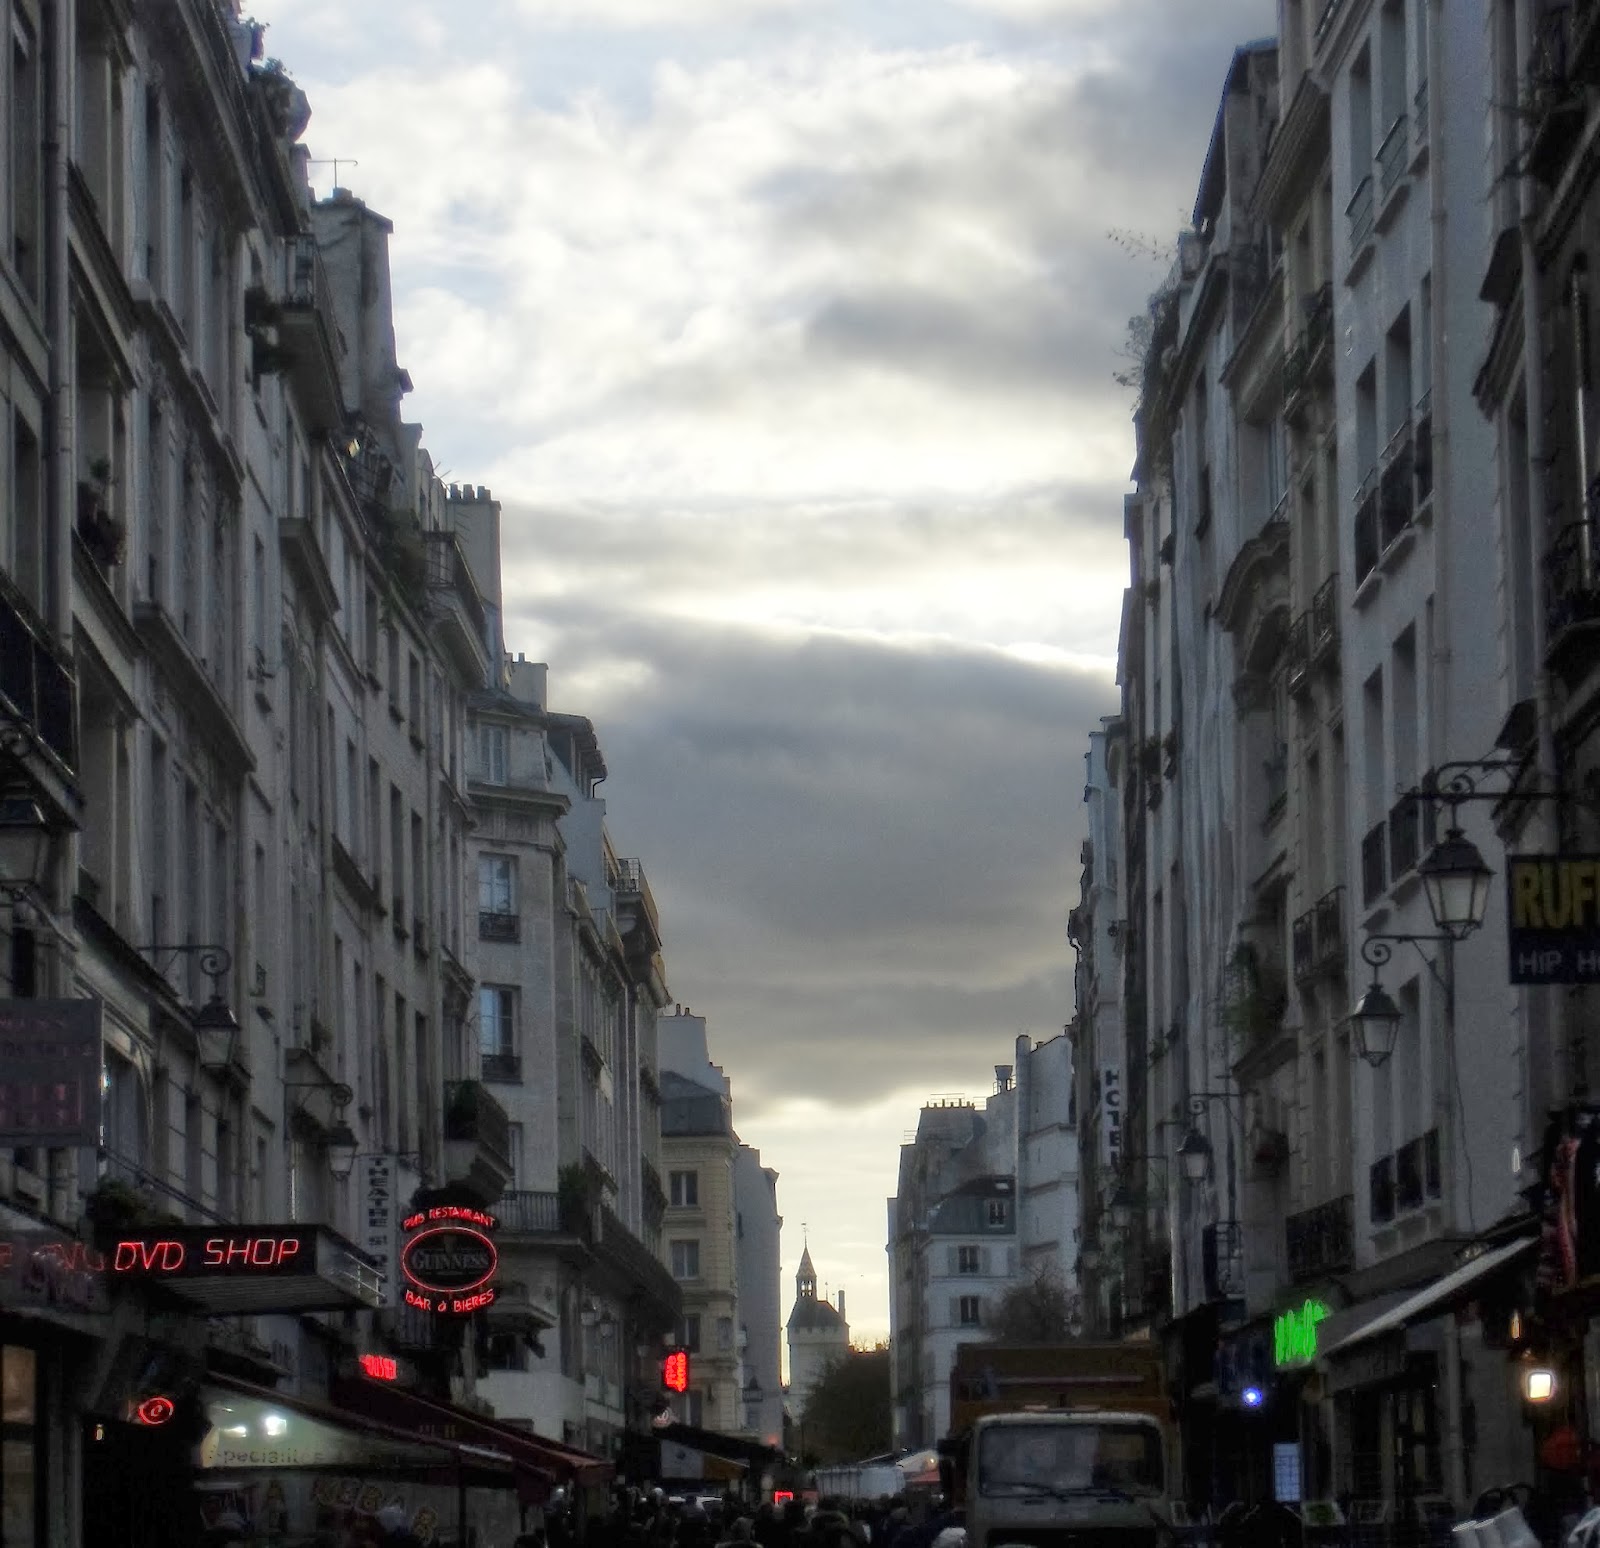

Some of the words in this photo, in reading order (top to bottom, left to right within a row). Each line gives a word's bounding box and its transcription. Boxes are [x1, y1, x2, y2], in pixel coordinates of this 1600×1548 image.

[1512, 861, 1600, 928] RUF
[1518, 949, 1563, 975] HIP
[1577, 949, 1600, 974] H
[403, 1213, 425, 1231] PUB
[428, 1206, 495, 1228] RESTAURANT
[114, 1241, 187, 1271] DVD
[203, 1238, 299, 1266] SHOP
[411, 1248, 489, 1271] GUINNESS
[405, 1290, 431, 1311] BAR
